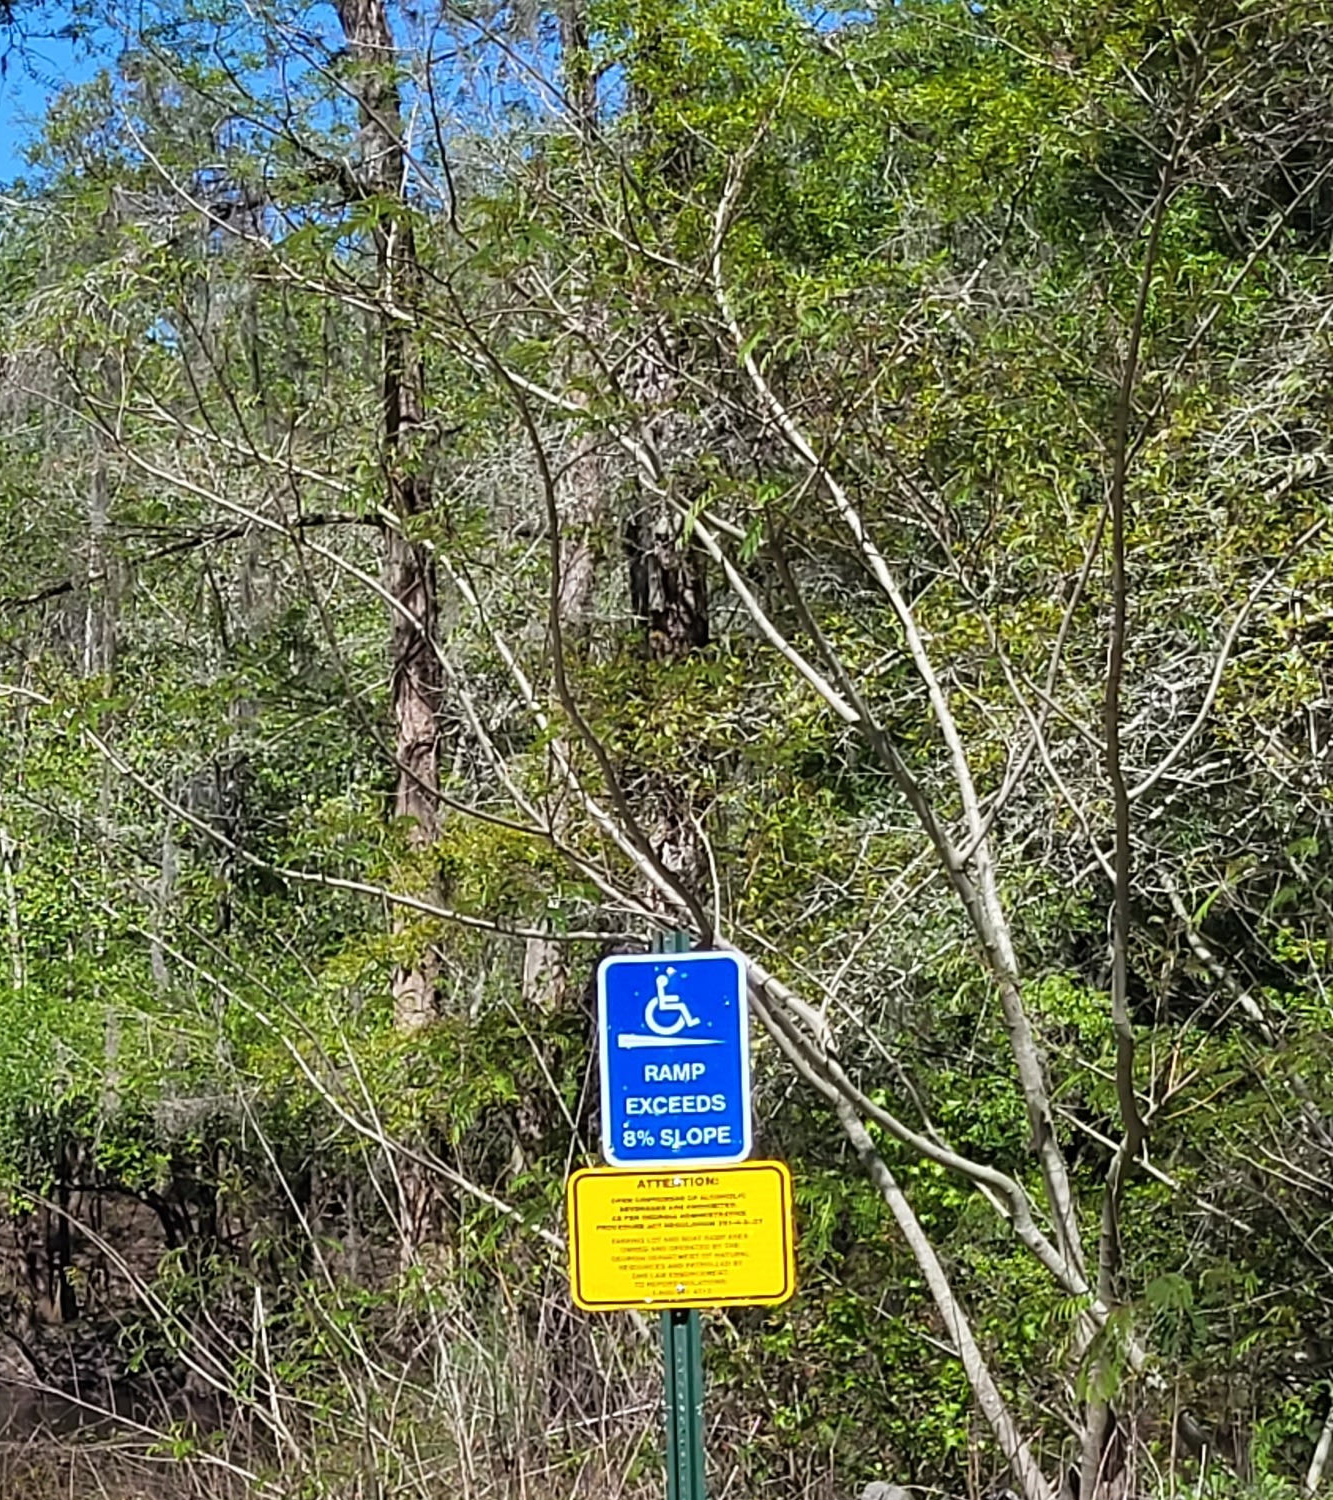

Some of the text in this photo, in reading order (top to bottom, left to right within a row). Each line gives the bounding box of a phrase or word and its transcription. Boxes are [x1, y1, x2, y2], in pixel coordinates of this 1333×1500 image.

[644, 1062, 706, 1082] RAMP
[625, 1094, 727, 1115] EXCEEDS
[623, 1126, 732, 1147] 8% SLOPE
